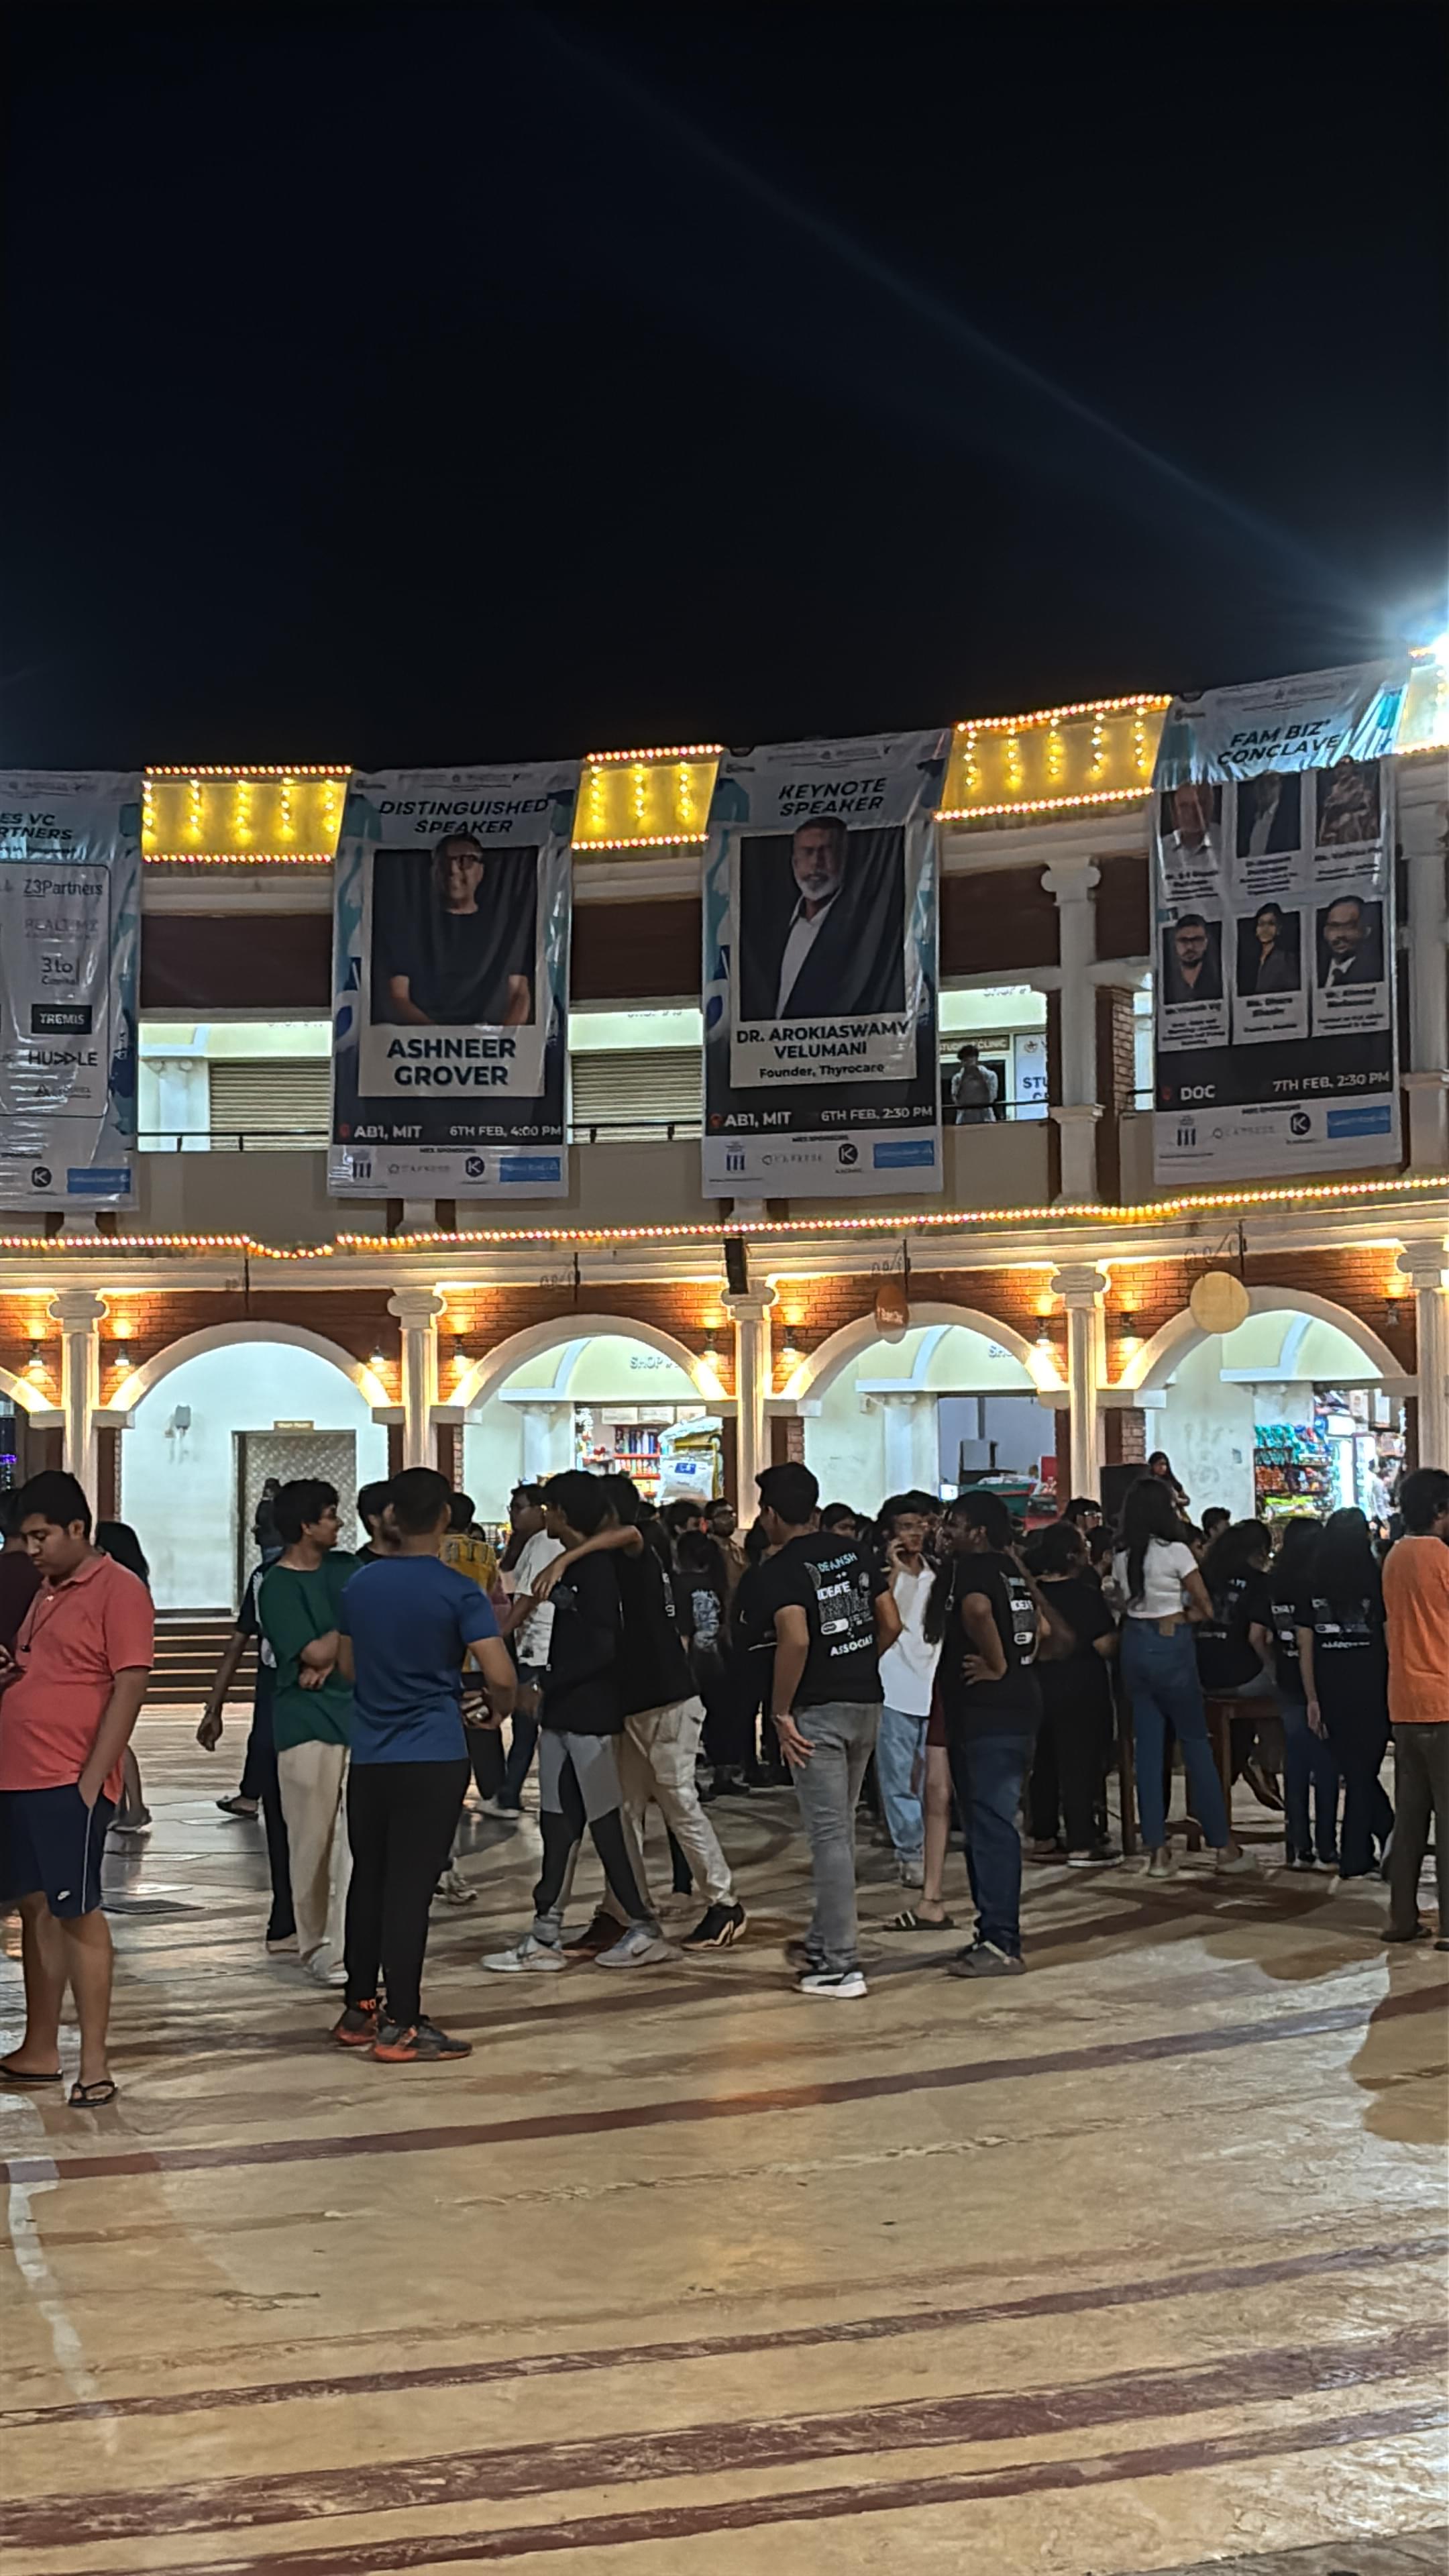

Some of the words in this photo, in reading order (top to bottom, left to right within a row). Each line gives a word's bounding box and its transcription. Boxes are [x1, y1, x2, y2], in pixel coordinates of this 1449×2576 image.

[1230, 727, 1279, 748] FAM
[1217, 734, 1340, 765] CONCLAVE
[779, 778, 886, 800] KEYNOTE
[379, 798, 548, 814] DISTINGUISHED
[780, 796, 884, 817] SPEAKER
[30, 814, 55, 826] VC
[415, 820, 513, 834] SPEAKER
[23, 879, 103, 896] Z3Partners
[737, 1030, 765, 1044] DR.
[769, 1021, 908, 1042] AROKIASWAMY
[387, 1038, 515, 1059] ASHNEER
[774, 1041, 867, 1059] VELUMANI
[394, 1066, 508, 1085] GROVER
[759, 1067, 816, 1078] Founder,
[819, 1063, 884, 1077] Thyrocare
[1273, 1079, 1298, 1091] 7TH
[1337, 1074, 1366, 1087] 2:30
[1368, 1071, 1390, 1085] PM
[1180, 1085, 1216, 1100] DOC
[724, 1112, 758, 1128] AB1,
[763, 1112, 792, 1126] MIT
[821, 1110, 847, 1122] 6TH
[883, 1107, 910, 1118] 2:30
[913, 1106, 933, 1117] PM
[354, 1126, 388, 1139] AB1,
[392, 1126, 422, 1138] MIT
[449, 1126, 474, 1136] 6TH
[478, 1126, 508, 1138] FEB,
[511, 1126, 539, 1136] 4:00
[542, 1126, 561, 1136] PM
